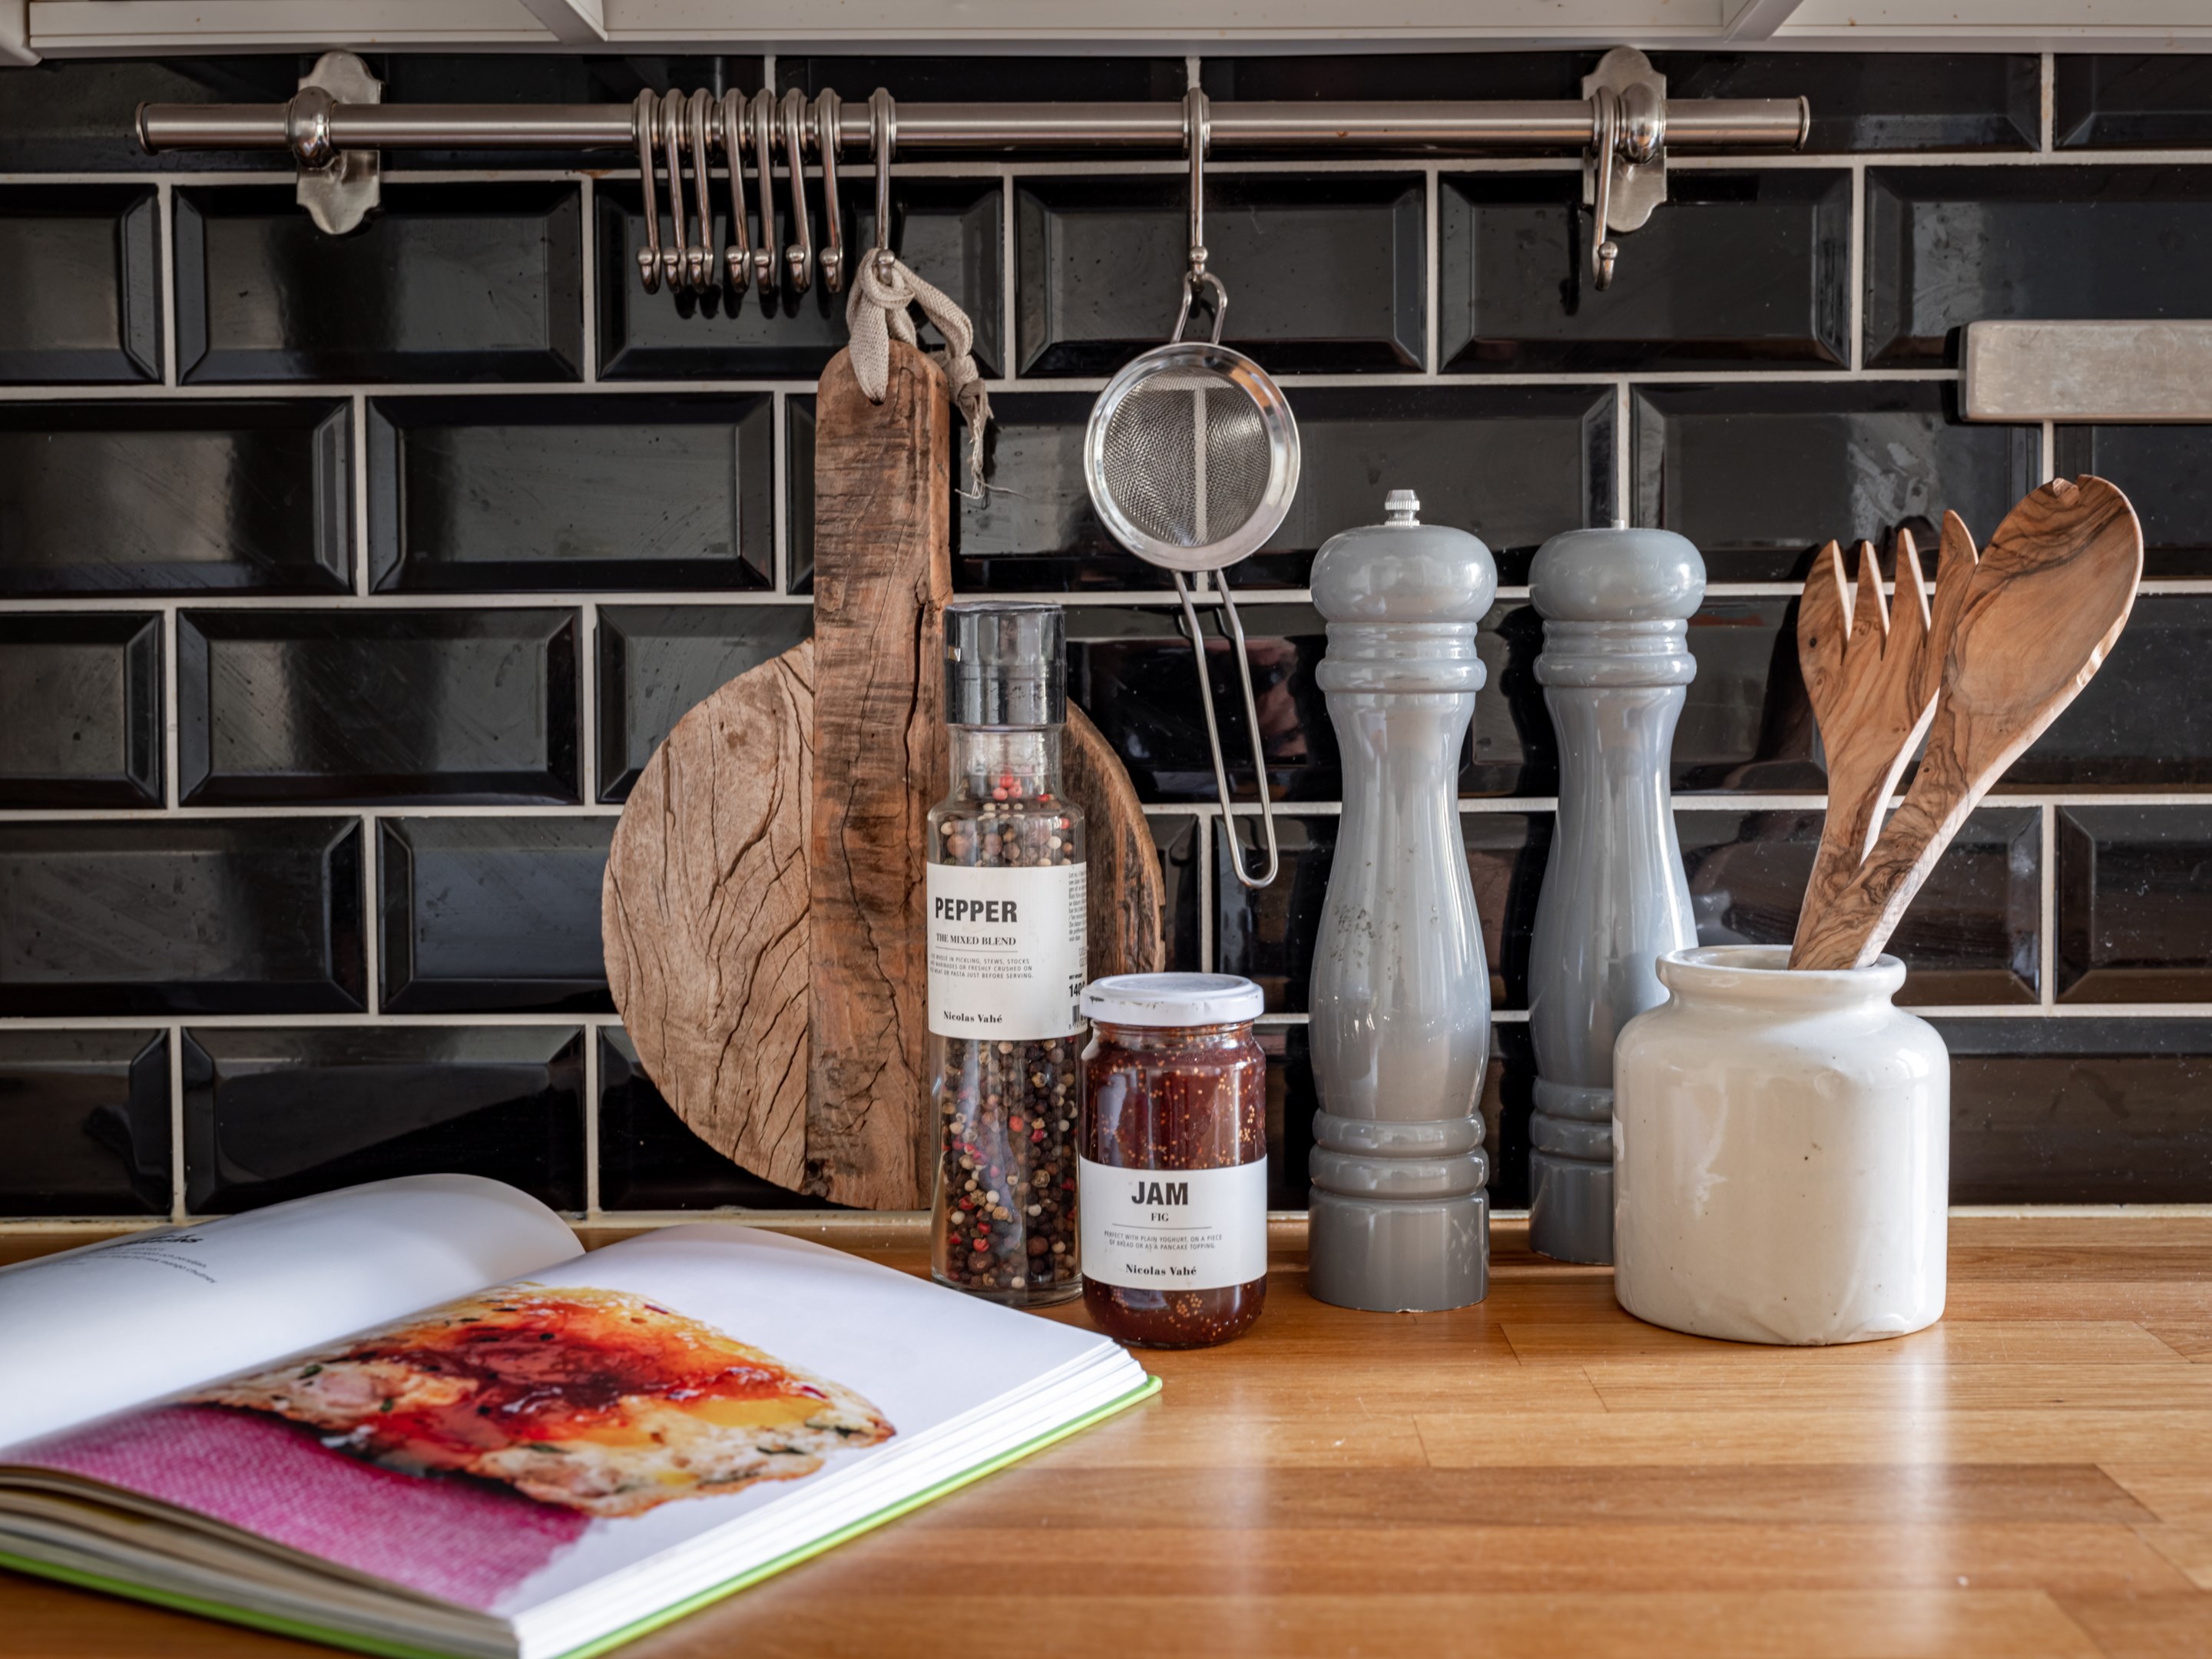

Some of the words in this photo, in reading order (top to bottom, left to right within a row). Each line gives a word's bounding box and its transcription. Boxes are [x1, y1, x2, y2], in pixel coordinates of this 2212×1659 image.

[935, 897, 1018, 922] PEPPER
[936, 933, 949, 942] THE
[950, 935, 979, 945] MIXED
[982, 936, 1016, 945] BLEND
[943, 1010, 975, 1022] Nicolas
[977, 1014, 1003, 1023] Vahé
[1131, 1181, 1188, 1206] JAM
[1151, 1213, 1169, 1222] FIG
[1104, 1230, 1124, 1240] PERFECT
[1125, 1263, 1166, 1275] Nicolas
[1170, 1266, 1197, 1276] Vahé
